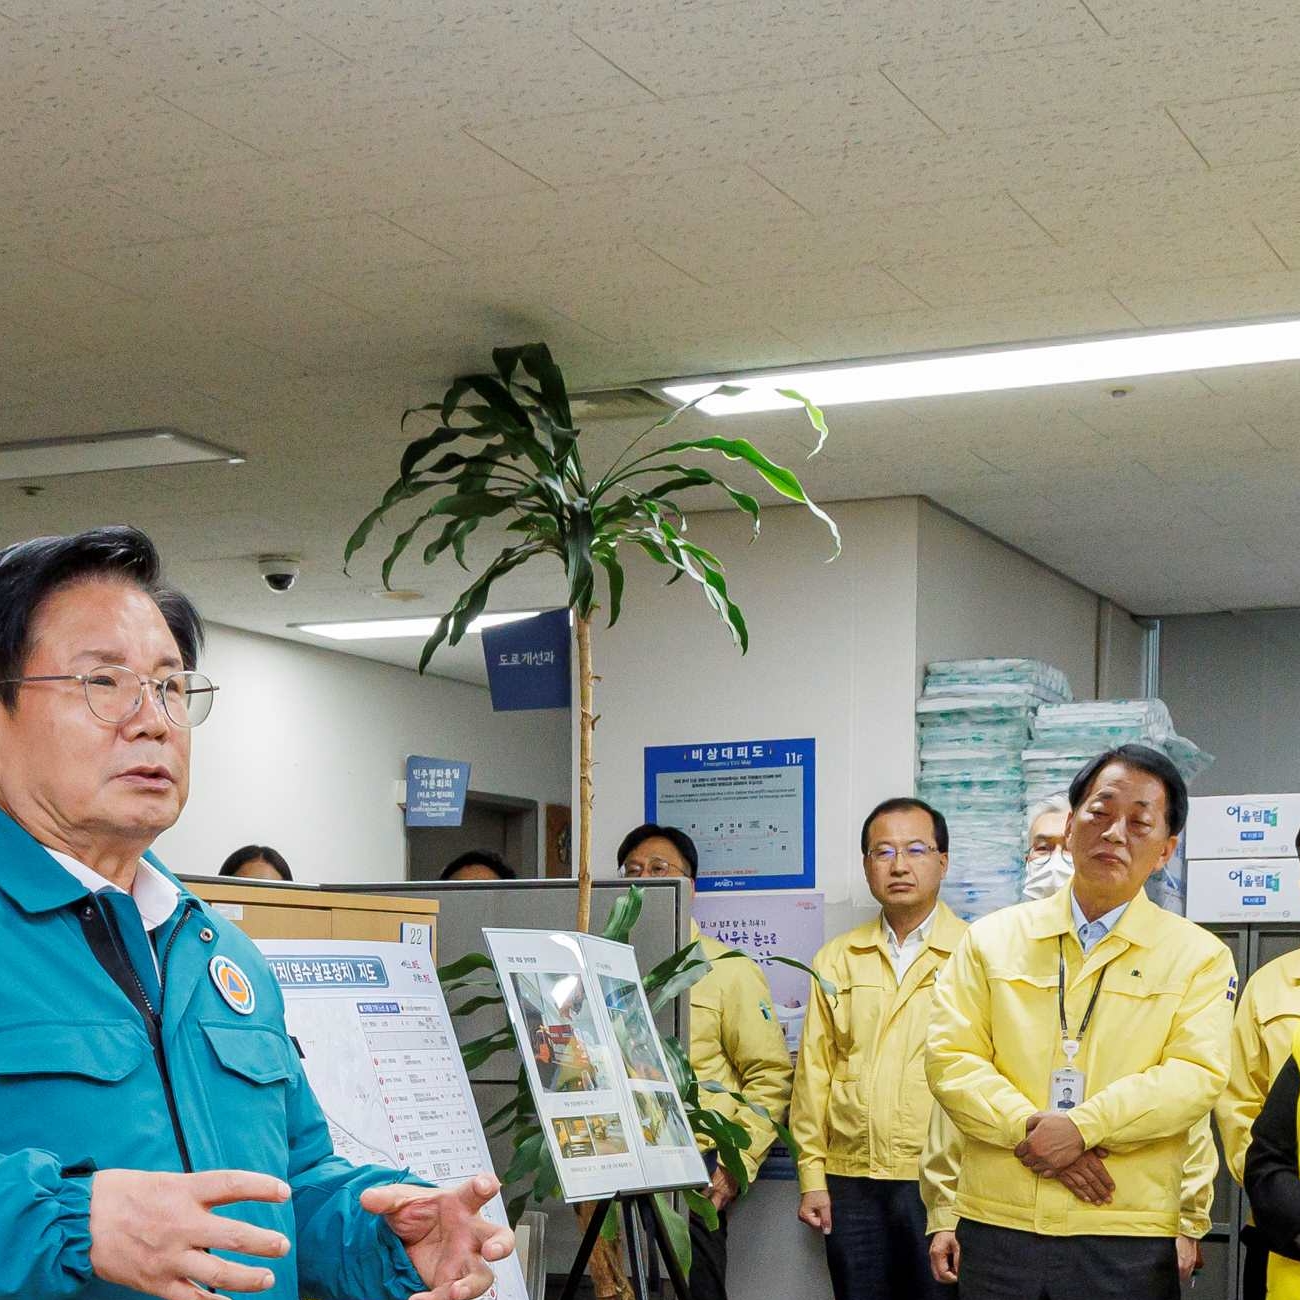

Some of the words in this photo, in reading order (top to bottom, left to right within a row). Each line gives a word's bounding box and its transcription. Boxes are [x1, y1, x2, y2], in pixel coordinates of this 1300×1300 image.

[498, 650, 555, 666] 도로개선과
[691, 745, 764, 761] 비상대피도
[785, 751, 803, 765] 11F
[409, 927, 422, 945] 22
[359, 962, 379, 982] 지도
